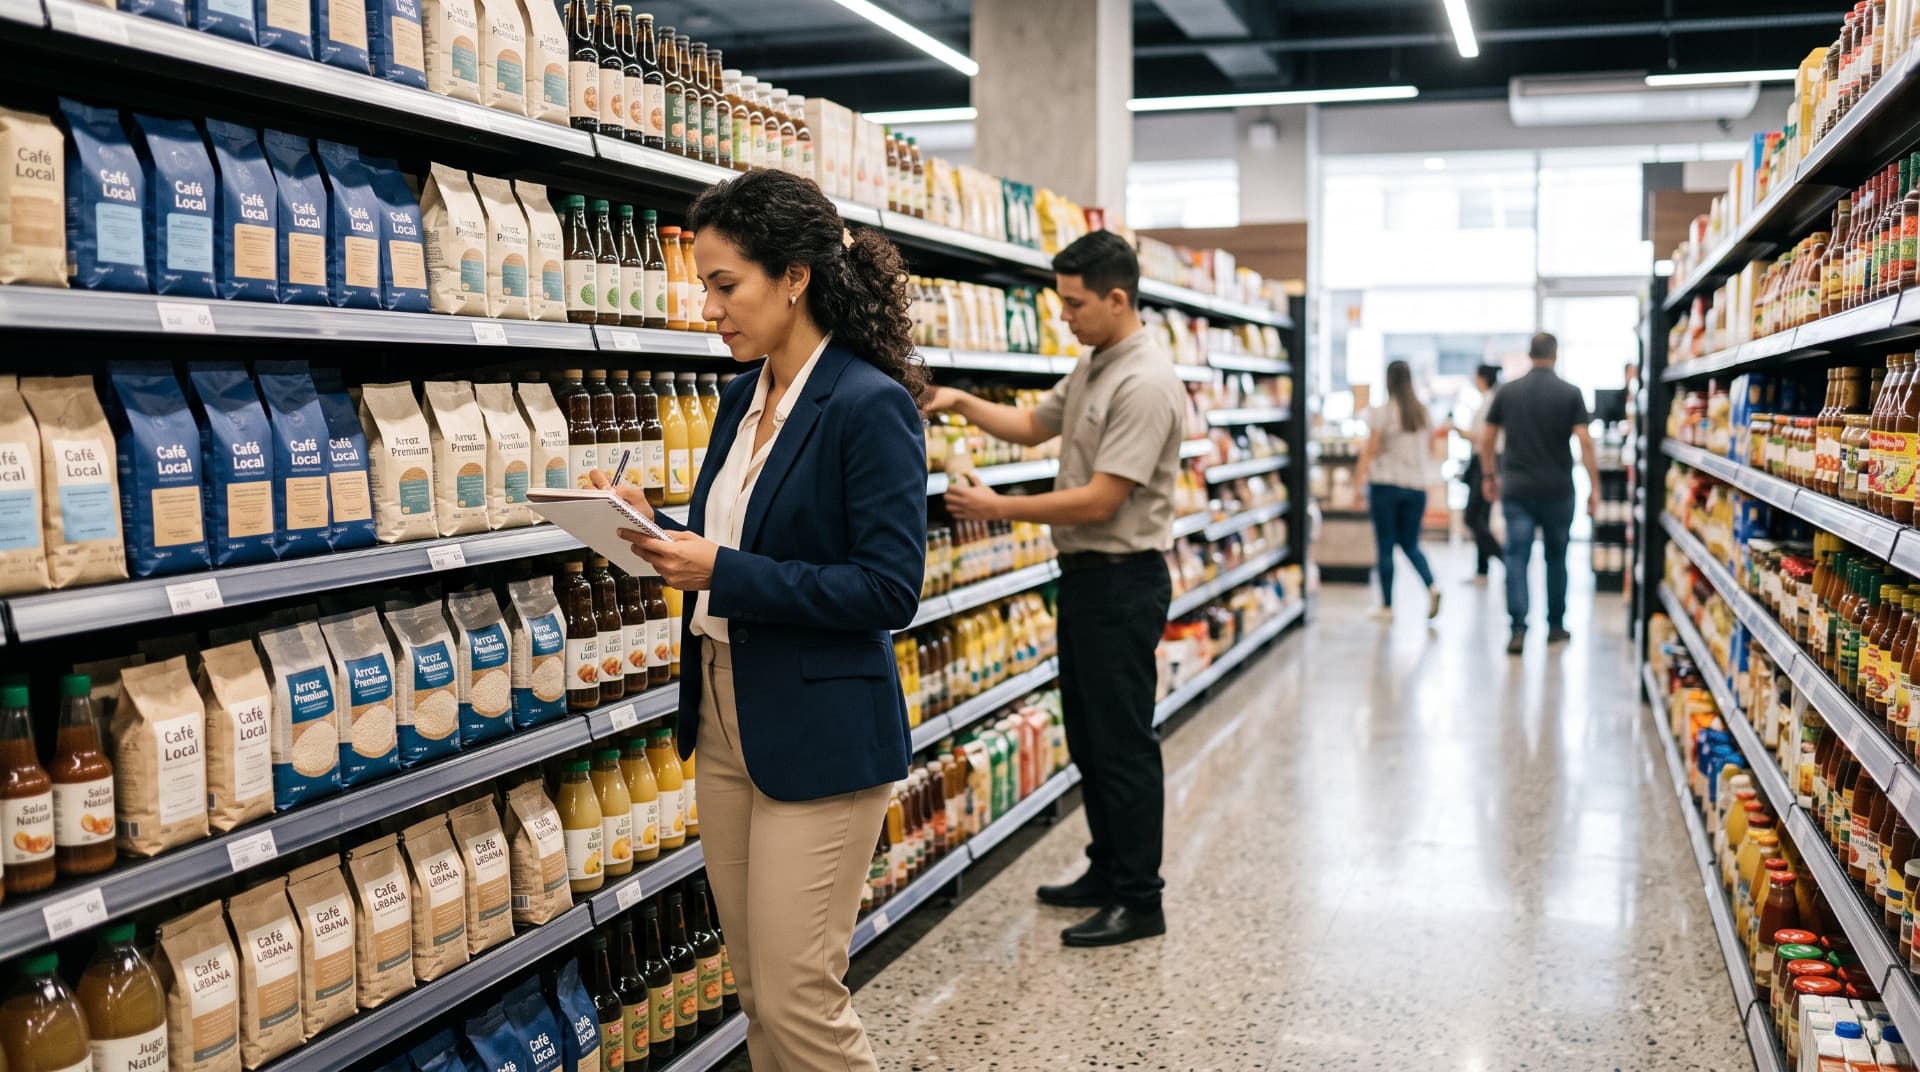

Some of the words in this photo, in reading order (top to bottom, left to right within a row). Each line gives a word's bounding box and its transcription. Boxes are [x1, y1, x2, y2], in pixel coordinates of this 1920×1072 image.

[17, 147, 52, 165] Café
[16, 163, 55, 182] Local
[101, 169, 130, 186] Café
[103, 183, 136, 201] Local
[175, 181, 203, 196] Café
[175, 195, 207, 211] Local
[241, 193, 264, 207] Café
[241, 205, 268, 221] Local
[292, 202, 316, 216] Café
[349, 207, 369, 220] Café
[294, 214, 320, 229] Local
[351, 218, 374, 233] Local
[390, 212, 412, 224] Café
[392, 222, 416, 236] Local
[232, 441, 260, 456] Café
[290, 438, 317, 452] Café
[329, 437, 352, 449] Café
[0, 451, 17, 465] fé
[64, 448, 95, 462] Café
[156, 444, 187, 459] Café
[291, 451, 321, 466] Local
[331, 449, 359, 462] Local
[391, 445, 429, 458] Premium
[158, 458, 192, 475] Local
[233, 454, 264, 469] Local
[0, 466, 26, 481] cal
[66, 462, 103, 477] Local
[355, 665, 380, 679] Arroz
[295, 680, 322, 694] Arroz
[354, 674, 388, 689] Premium
[294, 689, 329, 705] Premium
[238, 706, 264, 724] Café
[164, 724, 194, 744] Café
[240, 719, 267, 741] Local
[165, 739, 199, 761] Local
[475, 838, 496, 854] Café
[429, 860, 449, 875] Café
[374, 881, 397, 899] Café
[316, 905, 340, 923] Café
[257, 930, 284, 949] Café
[194, 957, 221, 977] Café
[575, 1015, 591, 1033] Café
[529, 1032, 550, 1052] Café
[578, 1025, 596, 1046] Local
[138, 1036, 163, 1055] Jugo
[532, 1043, 556, 1065] Local
